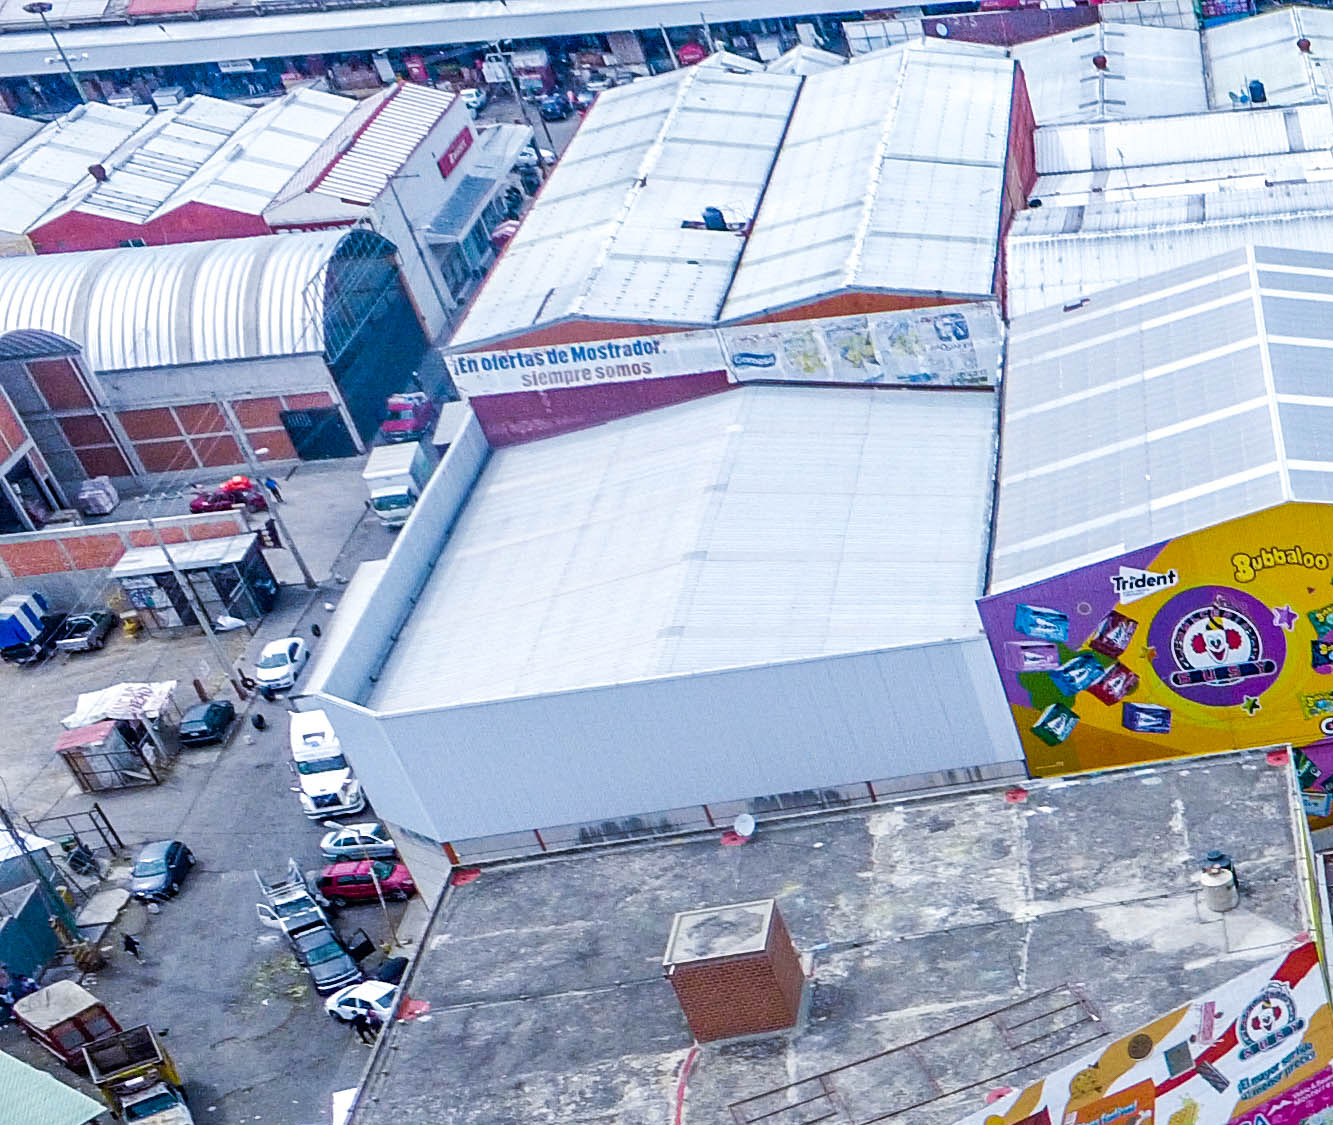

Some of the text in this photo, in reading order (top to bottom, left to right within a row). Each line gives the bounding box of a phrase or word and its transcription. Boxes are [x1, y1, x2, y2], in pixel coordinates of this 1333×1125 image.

[549, 347, 569, 365] de
[521, 361, 652, 387] siempre somos
[1231, 545, 1329, 583] Bubbaloo
[1112, 570, 1176, 591] Trident
